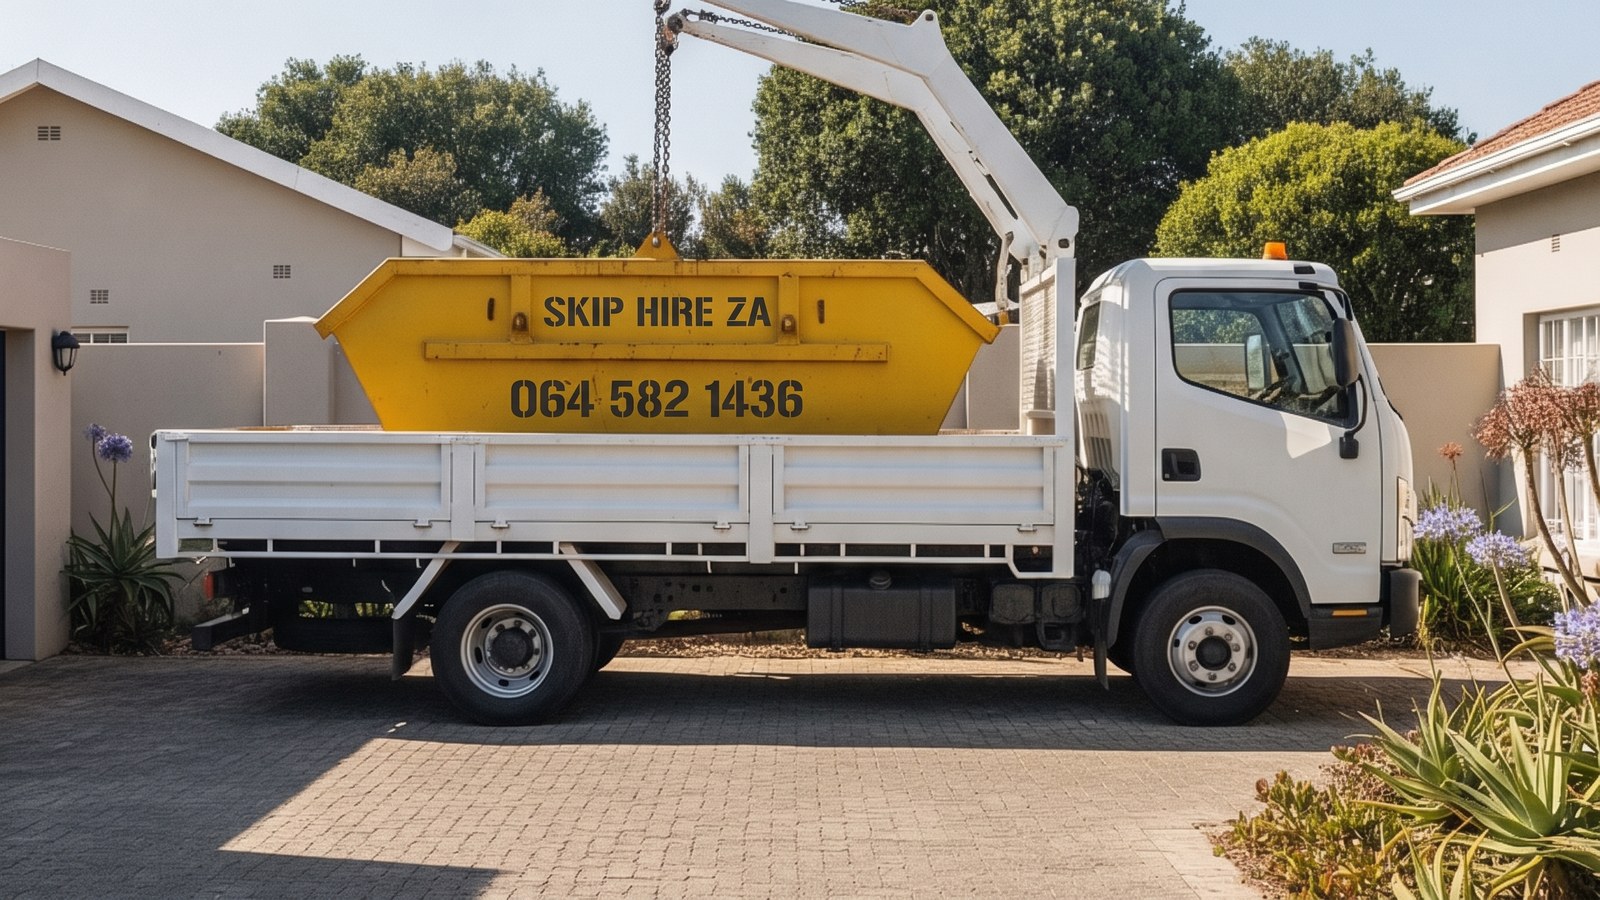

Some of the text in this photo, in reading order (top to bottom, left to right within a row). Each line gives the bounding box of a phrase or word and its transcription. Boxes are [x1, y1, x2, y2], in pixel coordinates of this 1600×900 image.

[543, 296, 772, 327] SKIP HIRE ZA
[510, 379, 804, 418] 064 582 1436
